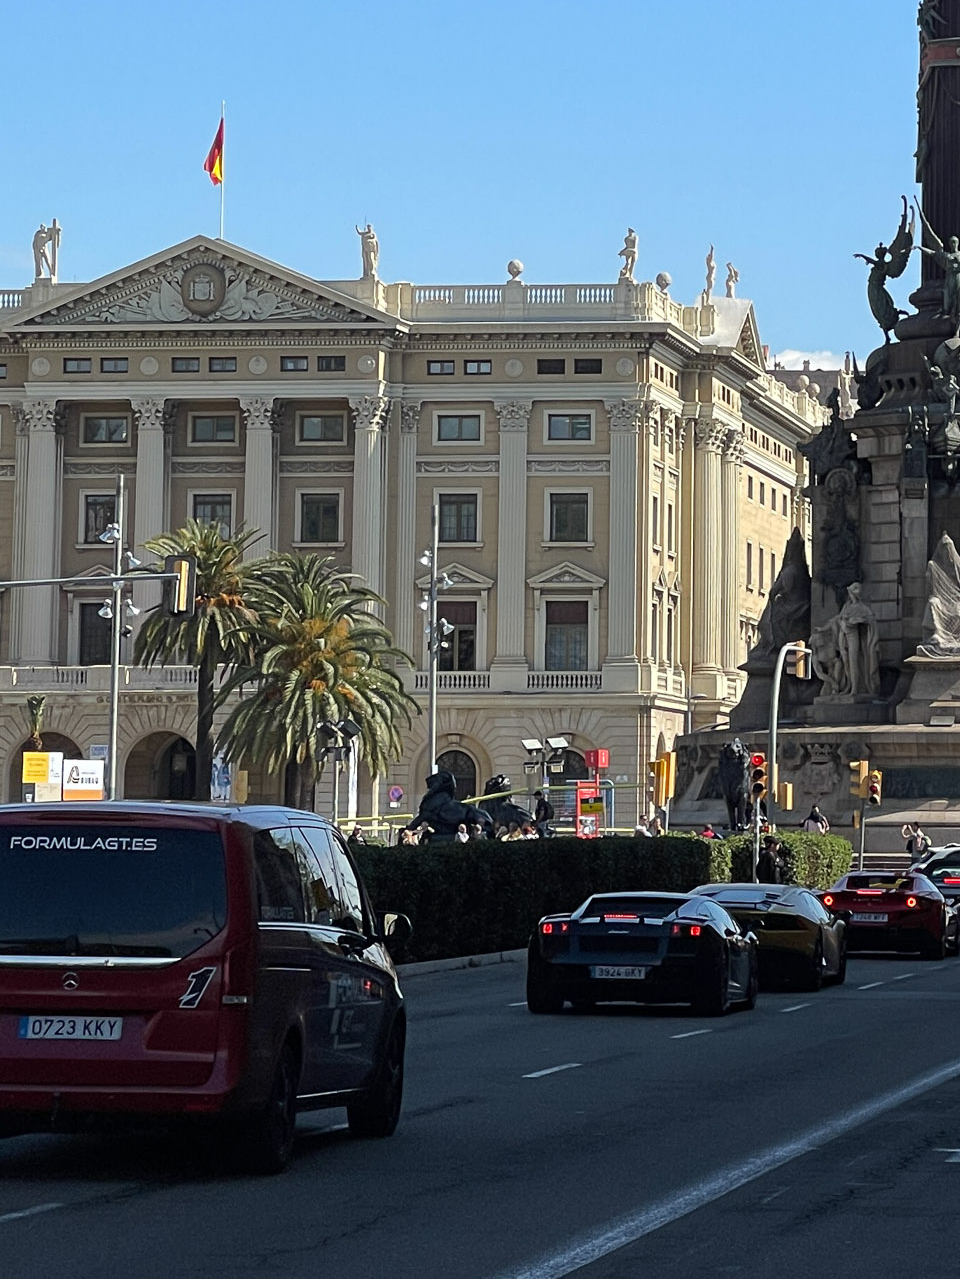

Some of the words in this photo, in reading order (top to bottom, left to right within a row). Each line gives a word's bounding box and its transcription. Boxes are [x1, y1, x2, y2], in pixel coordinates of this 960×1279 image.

[9, 836, 158, 851] FORMULAGT.ES
[598, 967, 622, 977] 3924
[624, 968, 644, 978] GKY
[31, 1019, 77, 1036] 0723
[82, 1019, 118, 1037] KKY
